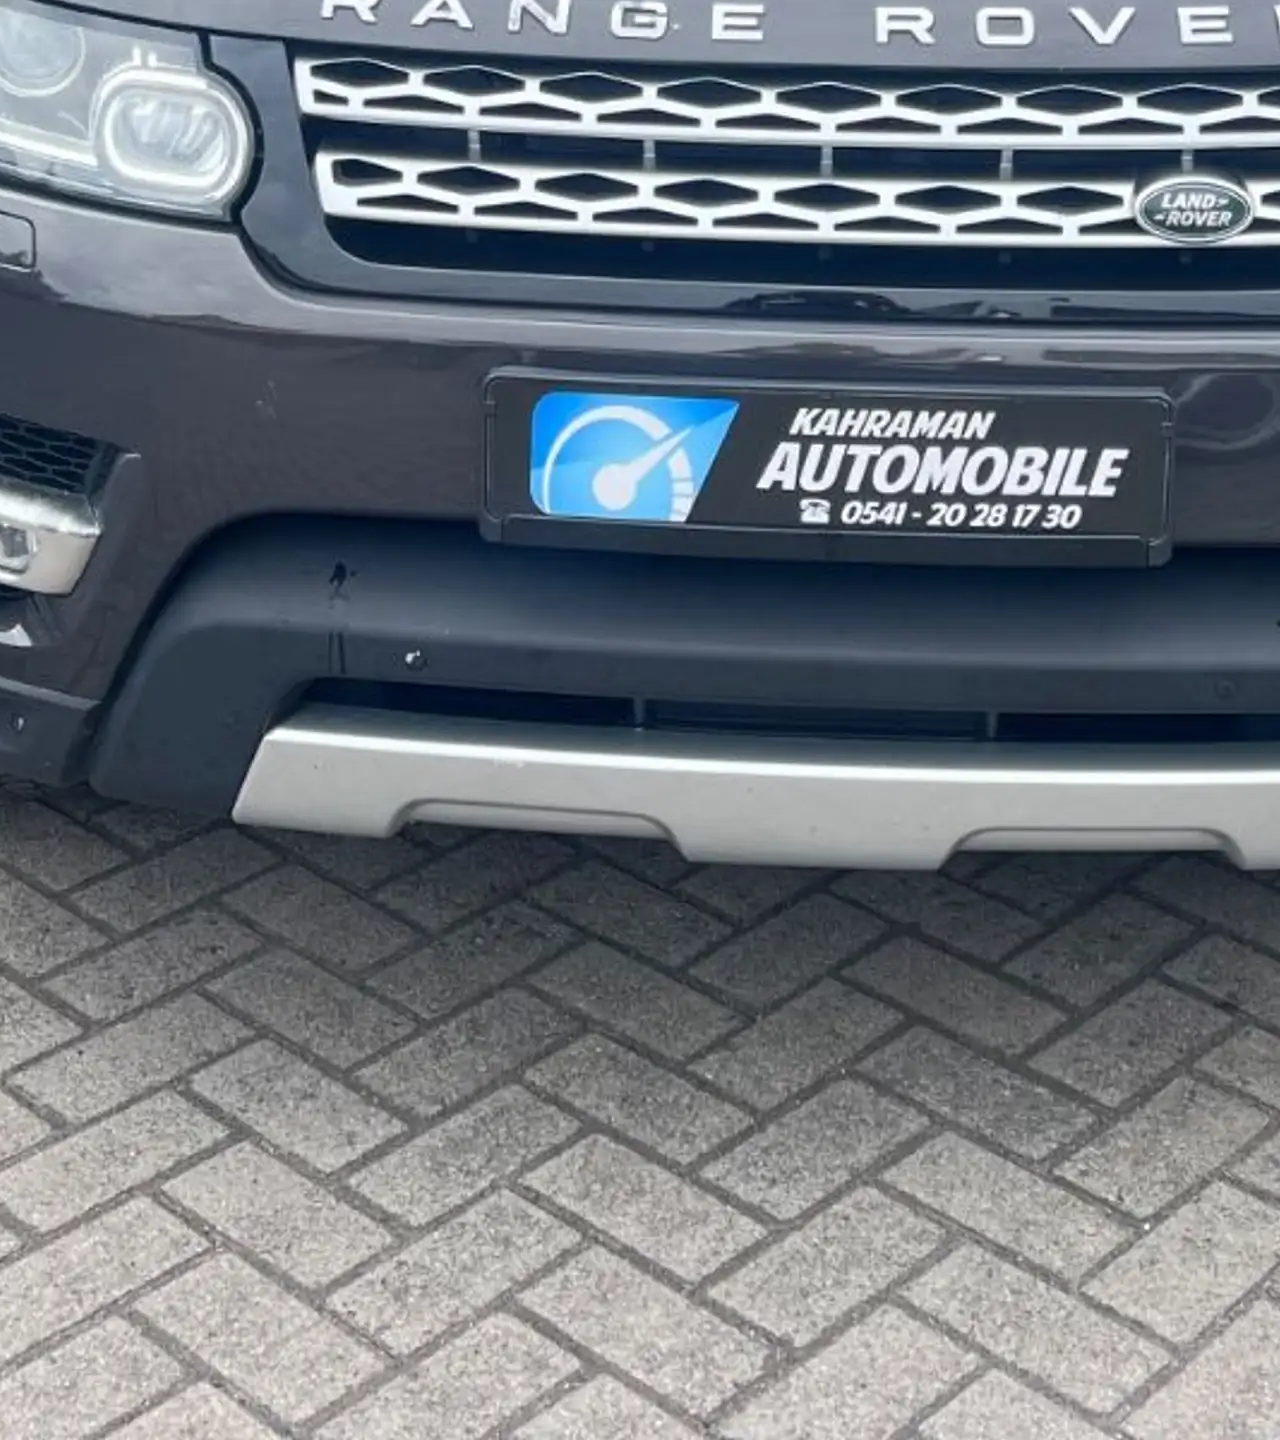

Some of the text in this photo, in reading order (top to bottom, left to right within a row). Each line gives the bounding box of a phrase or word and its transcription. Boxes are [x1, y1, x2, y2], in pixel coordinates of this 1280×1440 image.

[1161, 192, 1218, 209] LAND
[1165, 210, 1233, 227] ROVER
[789, 407, 996, 440] KAHRAMAN
[755, 441, 1130, 498] AUTOMOBILE
[840, 501, 906, 527] 0541
[929, 503, 967, 529] 20
[970, 504, 1008, 530] 28
[1013, 504, 1040, 530] 17
[1041, 504, 1083, 531] 30
